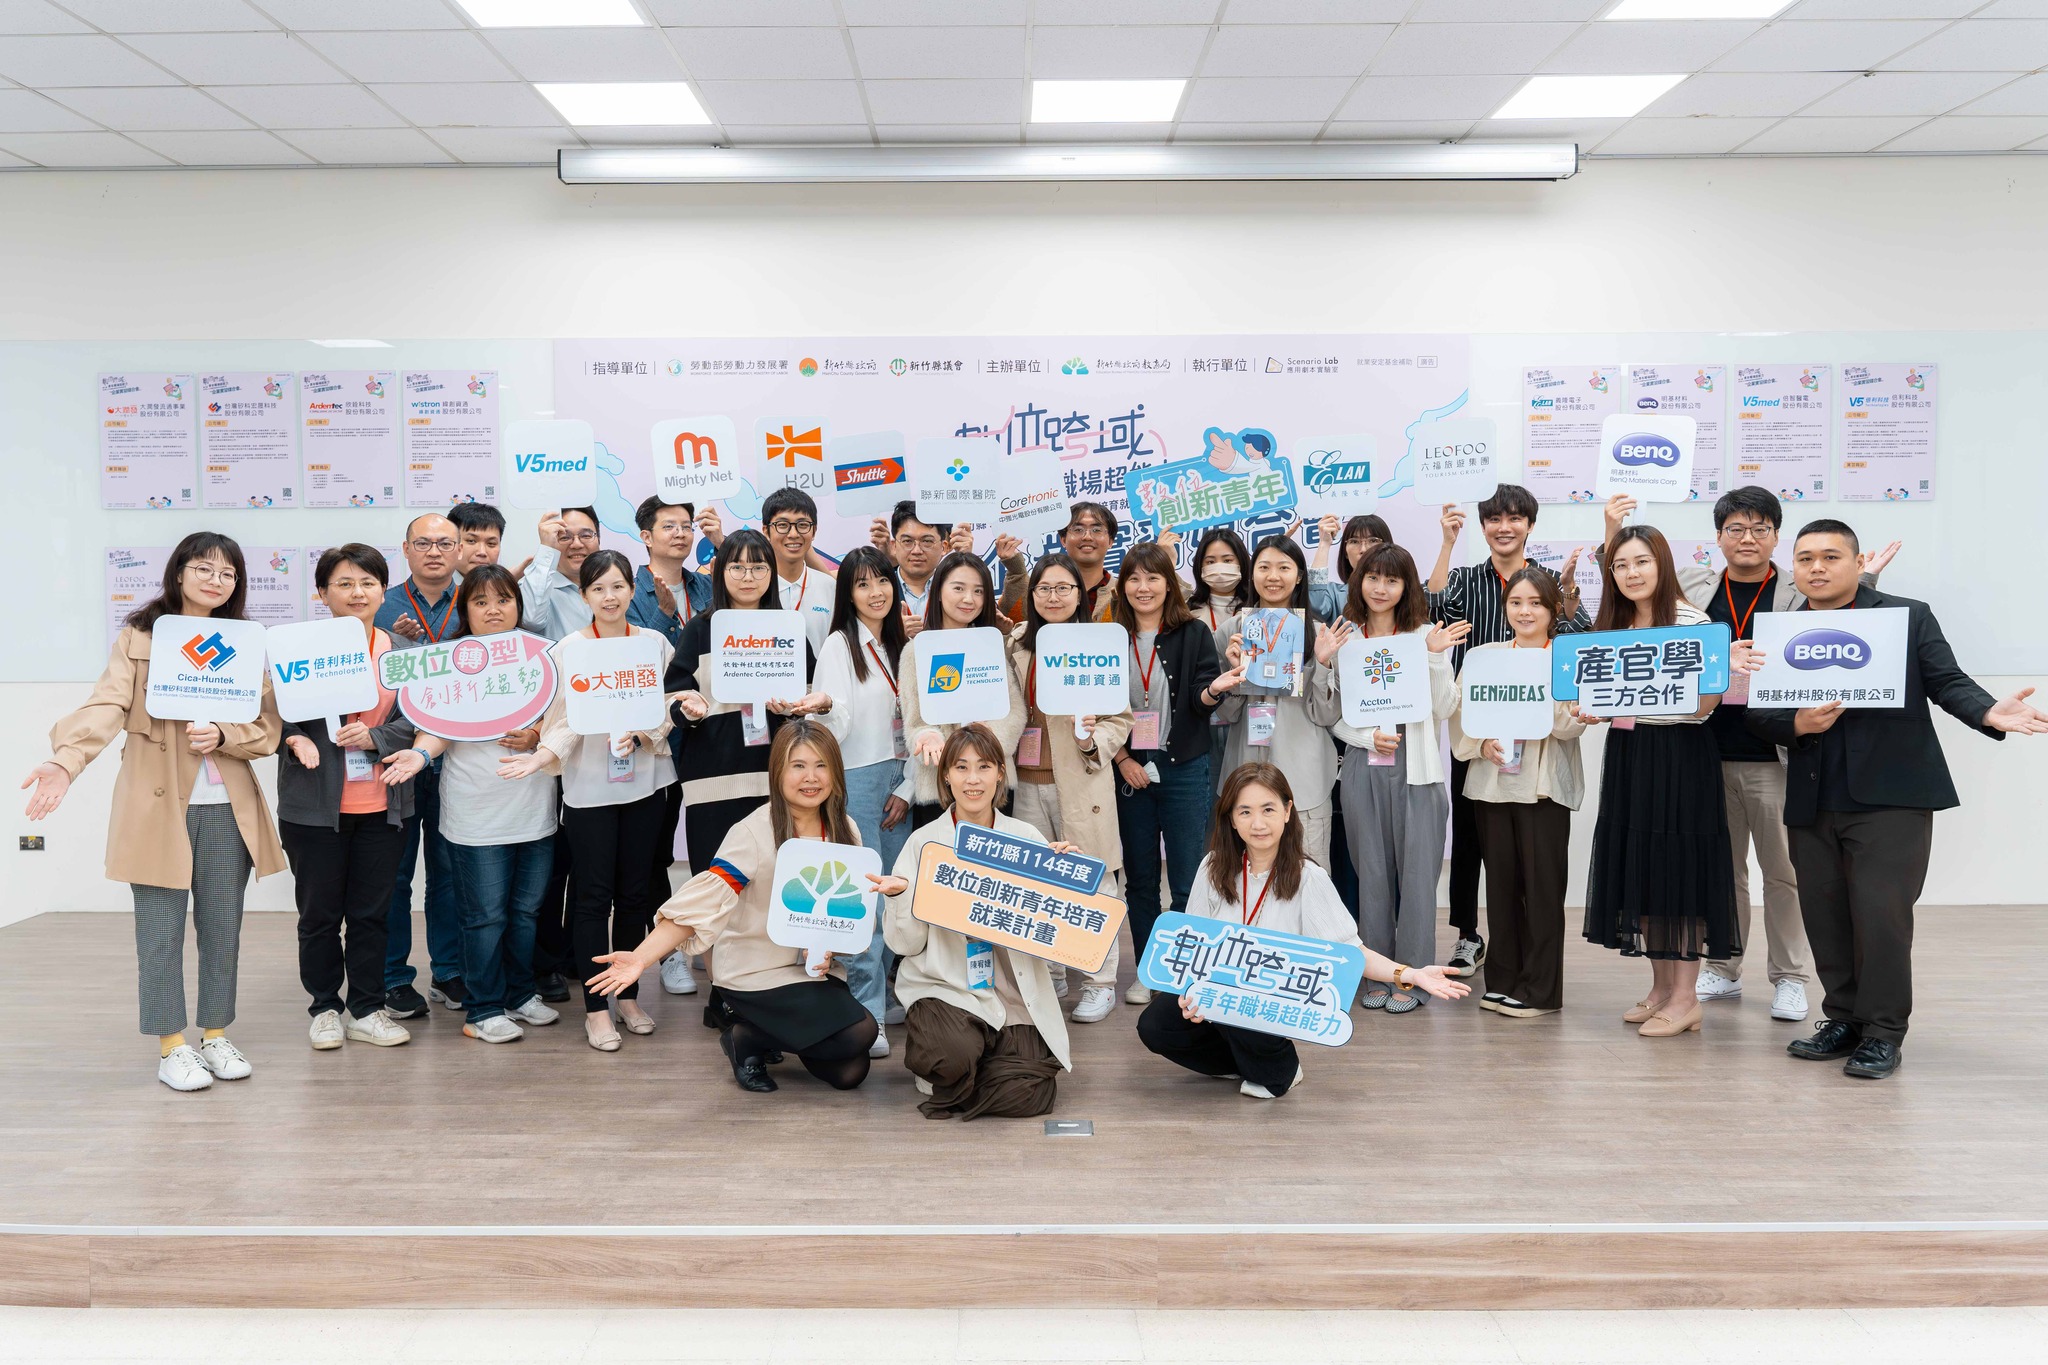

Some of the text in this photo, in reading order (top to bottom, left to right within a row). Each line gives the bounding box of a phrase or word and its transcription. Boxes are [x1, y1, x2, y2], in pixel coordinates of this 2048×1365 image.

[592, 361, 648, 376] 指導單位
[690, 360, 789, 370] 勞動部勞動力發展署
[909, 360, 964, 372] 新竹縣議會
[986, 359, 1042, 374] 主辦單位
[1192, 358, 1248, 373] 執行單位
[1287, 356, 1339, 365] Scenario Lab
[1356, 358, 1413, 366] 就業安定基金補助
[1420, 358, 1434, 366] 廣告
[1287, 366, 1339, 374] 應用劇本實驗室
[1743, 396, 1781, 407] V5med
[1849, 397, 1864, 407] V5
[115, 406, 138, 414] 大潤發
[1425, 442, 1487, 459] LEOFOO
[1620, 444, 1675, 461] BenQ
[515, 453, 588, 473] V5med
[1421, 456, 1490, 472] 六福旅遊集團
[664, 470, 733, 489] Mighty Net
[785, 473, 824, 489] H2U
[841, 467, 887, 485] Shuttle
[1308, 449, 1366, 499] ELAN
[1609, 476, 1628, 484] BenQ
[1628, 477, 1659, 485] Materials
[920, 489, 997, 500] 聯新國際醫院
[1000, 487, 1059, 510] Coretronic
[1157, 473, 1285, 525] 創新青年
[722, 634, 795, 649] Ardentec
[313, 651, 365, 670] 倍利科技
[1043, 652, 1120, 668] wistron
[1794, 643, 1864, 662] BenQ
[384, 637, 519, 685] 數位轉型
[965, 665, 1000, 673] INTEGRATED
[1575, 640, 1703, 685] 產官學
[177, 673, 235, 684] Cica-Huntek
[275, 659, 310, 684] V5
[315, 666, 367, 679] Technologies
[591, 668, 657, 691] 大潤發
[966, 677, 1004, 685] TECHNOLOGY
[1063, 674, 1121, 686] 緯創資通
[1360, 697, 1392, 707] Accton
[1591, 684, 1684, 708] 三方合作
[1757, 688, 1895, 702] 明基材料股份有限公司
[965, 833, 1093, 884] 新竹縣114年度
[933, 863, 1108, 933] 數位創新青年培育
[968, 902, 1058, 946] 就業計畫
[1160, 928, 1329, 1007] 數位跨域
[1195, 987, 1342, 1038] 青年職場超能力
